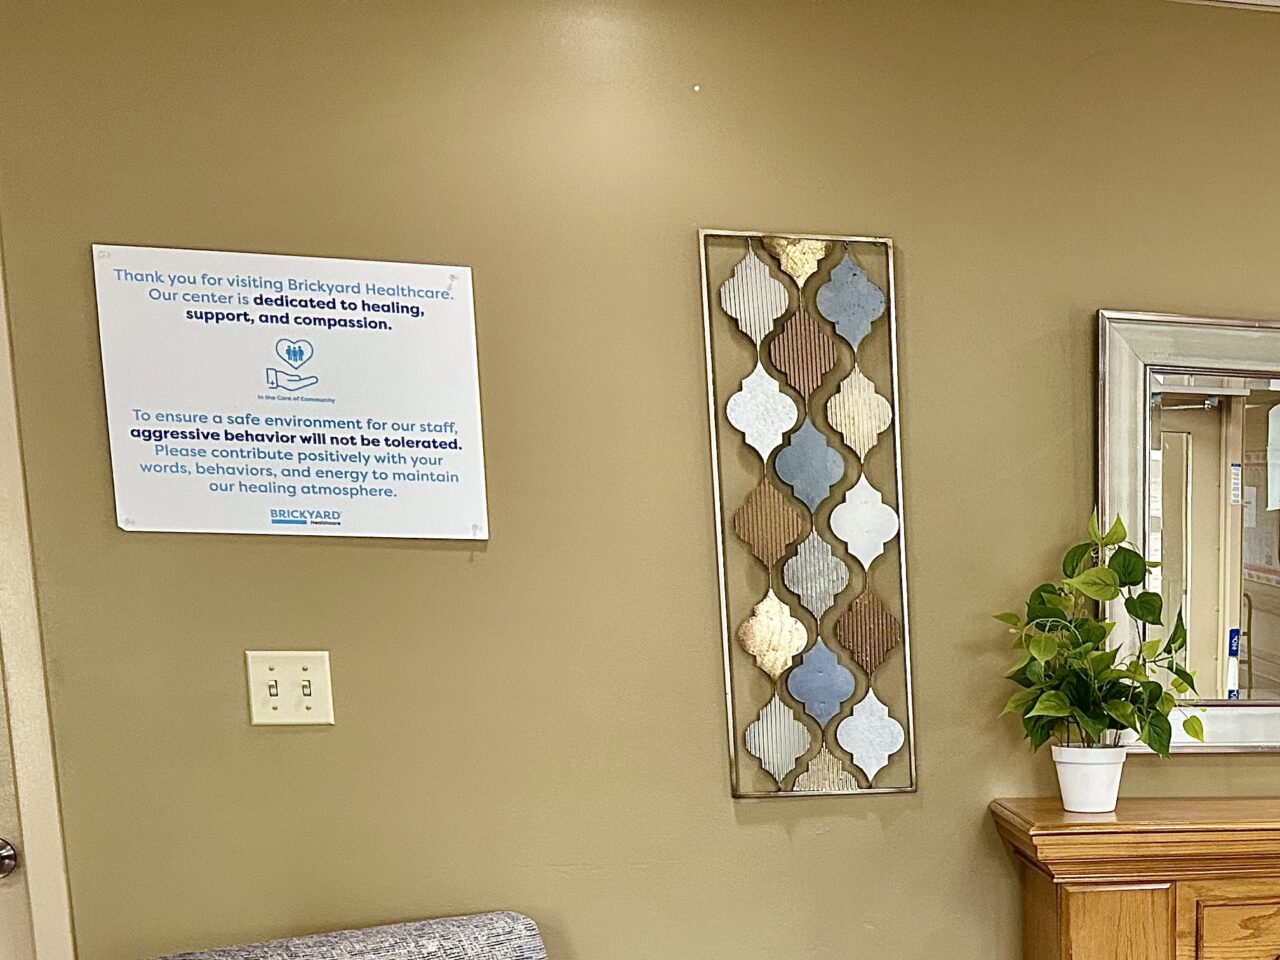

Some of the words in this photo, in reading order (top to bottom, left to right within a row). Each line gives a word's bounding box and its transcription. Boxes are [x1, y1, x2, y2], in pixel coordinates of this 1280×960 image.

[113, 268, 164, 283] Thank
[167, 273, 197, 287] you
[201, 273, 223, 286] for
[227, 275, 283, 292] visiting
[288, 278, 361, 296] Brickyard
[366, 283, 454, 300] Healthcare.
[149, 288, 178, 301] Our
[182, 292, 234, 304] center
[237, 293, 249, 305] is
[253, 293, 336, 310] dedicated
[340, 299, 357, 311] to
[361, 300, 424, 318] healing,
[186, 310, 255, 325] support,
[258, 312, 290, 325] and
[294, 315, 393, 330] compassion.
[132, 409, 151, 422] To
[155, 411, 209, 424] ensure
[212, 414, 223, 424] a
[227, 413, 260, 426] safe
[264, 415, 363, 430] environment
[367, 418, 388, 431] for
[391, 421, 416, 433] our
[419, 421, 458, 435] staff,
[130, 428, 221, 442] aggressive
[224, 429, 297, 444] behavior
[299, 433, 326, 445] will
[330, 435, 357, 446] not
[360, 434, 381, 447] be
[384, 436, 463, 450] tolerated.
[154, 444, 207, 458] Please
[211, 447, 293, 461] contribute
[297, 450, 371, 466] positively
[374, 453, 407, 465] with
[411, 455, 443, 468] your
[140, 461, 192, 475] words,
[195, 462, 277, 478] behaviors,
[281, 466, 311, 478] and
[315, 468, 368, 483] energy
[372, 469, 389, 481] to
[392, 470, 459, 483] maintain
[209, 482, 235, 492] our
[238, 481, 296, 497] healing
[301, 484, 398, 499] atmosphere.
[270, 509, 341, 520] BRICKYARD
